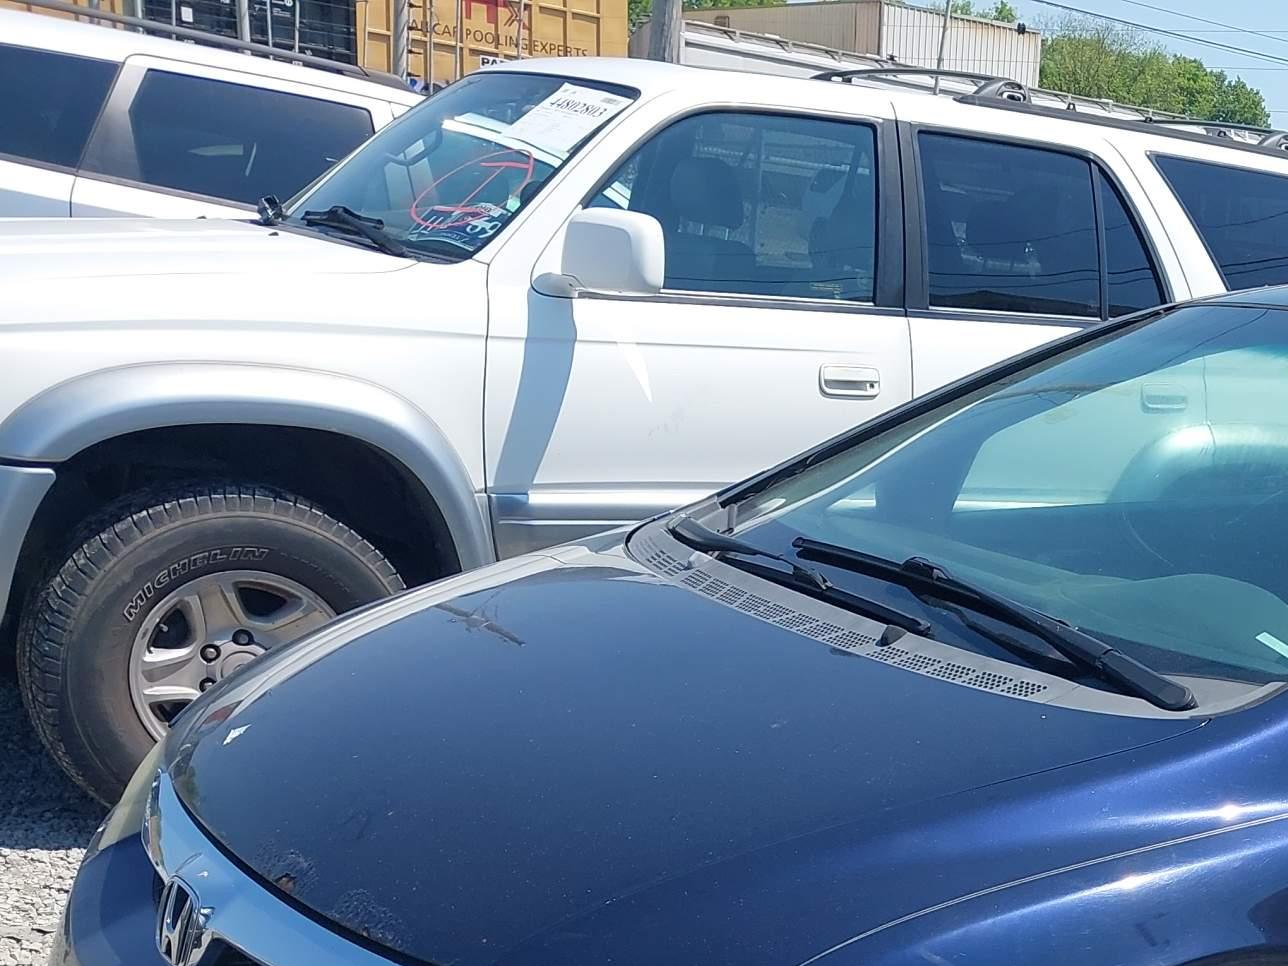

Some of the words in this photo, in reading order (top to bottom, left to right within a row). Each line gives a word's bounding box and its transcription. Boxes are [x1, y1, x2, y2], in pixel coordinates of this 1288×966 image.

[465, 28, 528, 51] POOLING
[533, 39, 588, 57] EXPERTS
[549, 97, 608, 118] 44802803
[124, 548, 269, 621] MICHELIN
